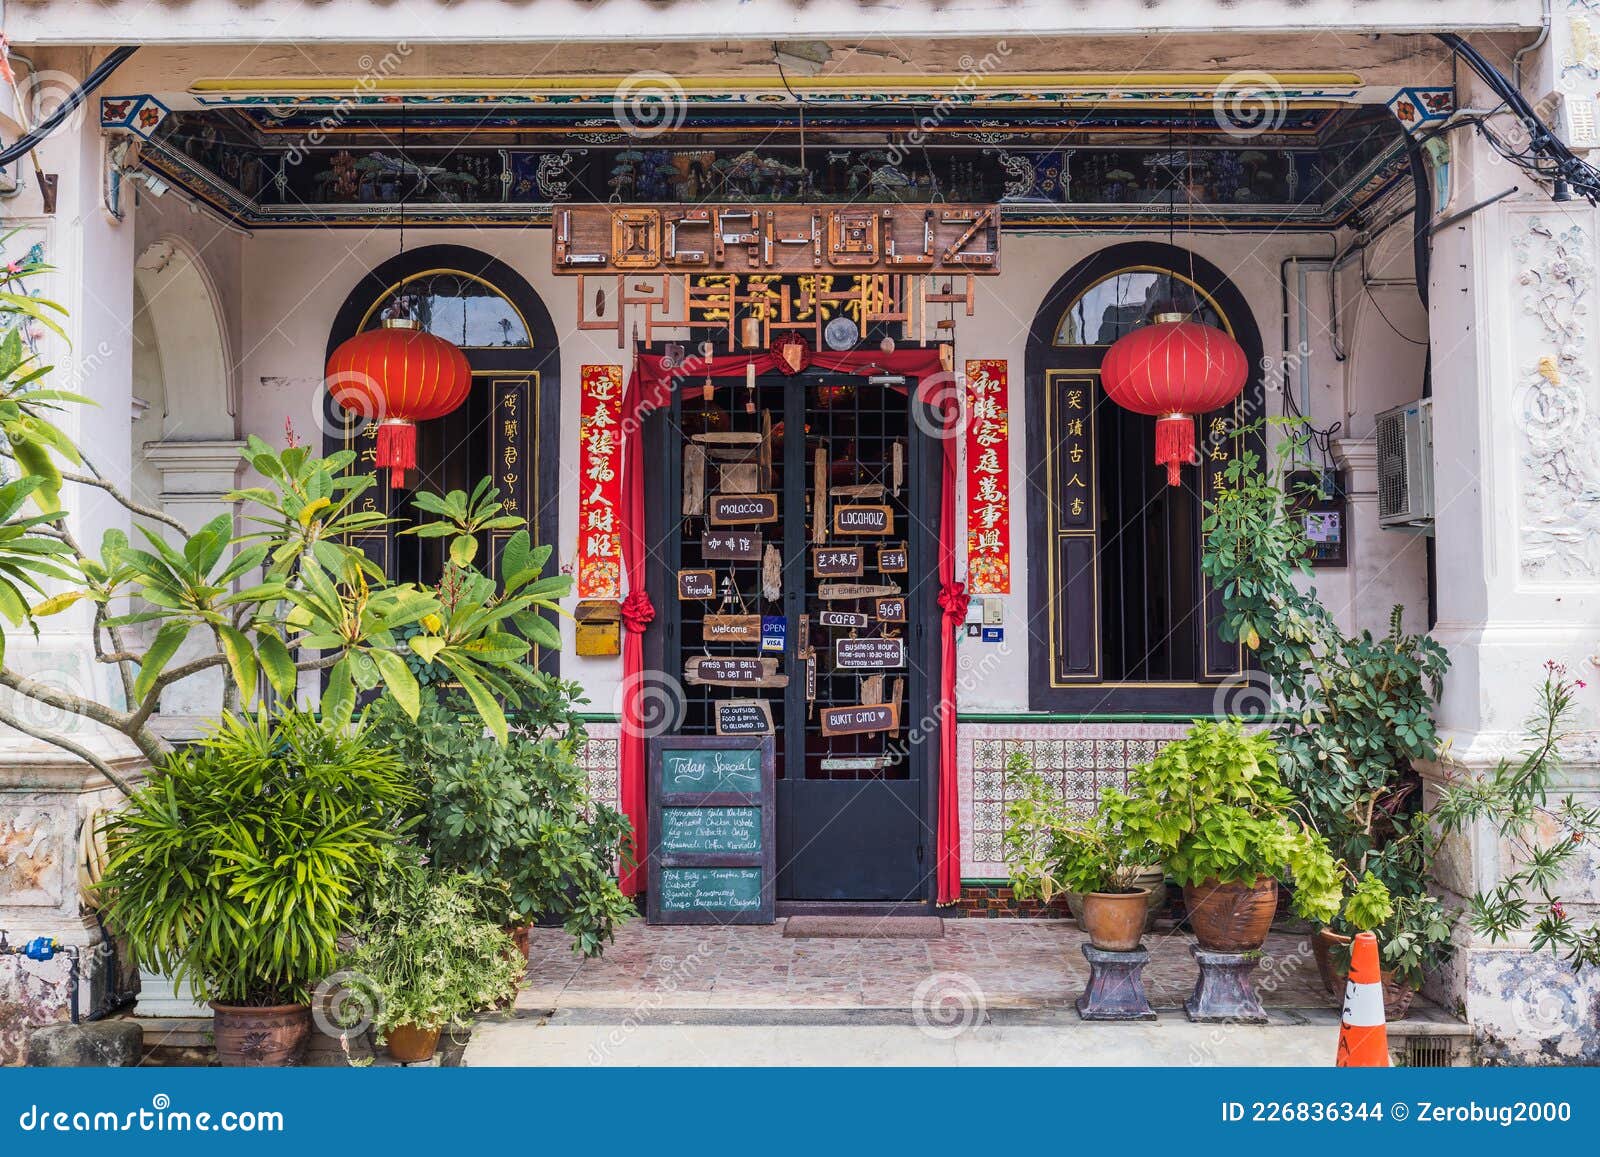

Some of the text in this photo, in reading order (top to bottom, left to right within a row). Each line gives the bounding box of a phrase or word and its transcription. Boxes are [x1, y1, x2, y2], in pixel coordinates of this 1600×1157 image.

[556, 207, 998, 268] LOCAHOUZ
[973, 370, 1004, 554] 和睦家庭萬事興
[1066, 389, 1087, 516] 笑讀古人書
[586, 375, 617, 558] 迎春接福人財旺
[707, 537, 751, 552] 咖啡馆
[818, 553, 858, 567] 艺术展厅
[711, 624, 748, 634] welcome
[763, 623, 786, 633] OPEN
[830, 713, 853, 726] BUKIT
[669, 752, 757, 783] Today Special
